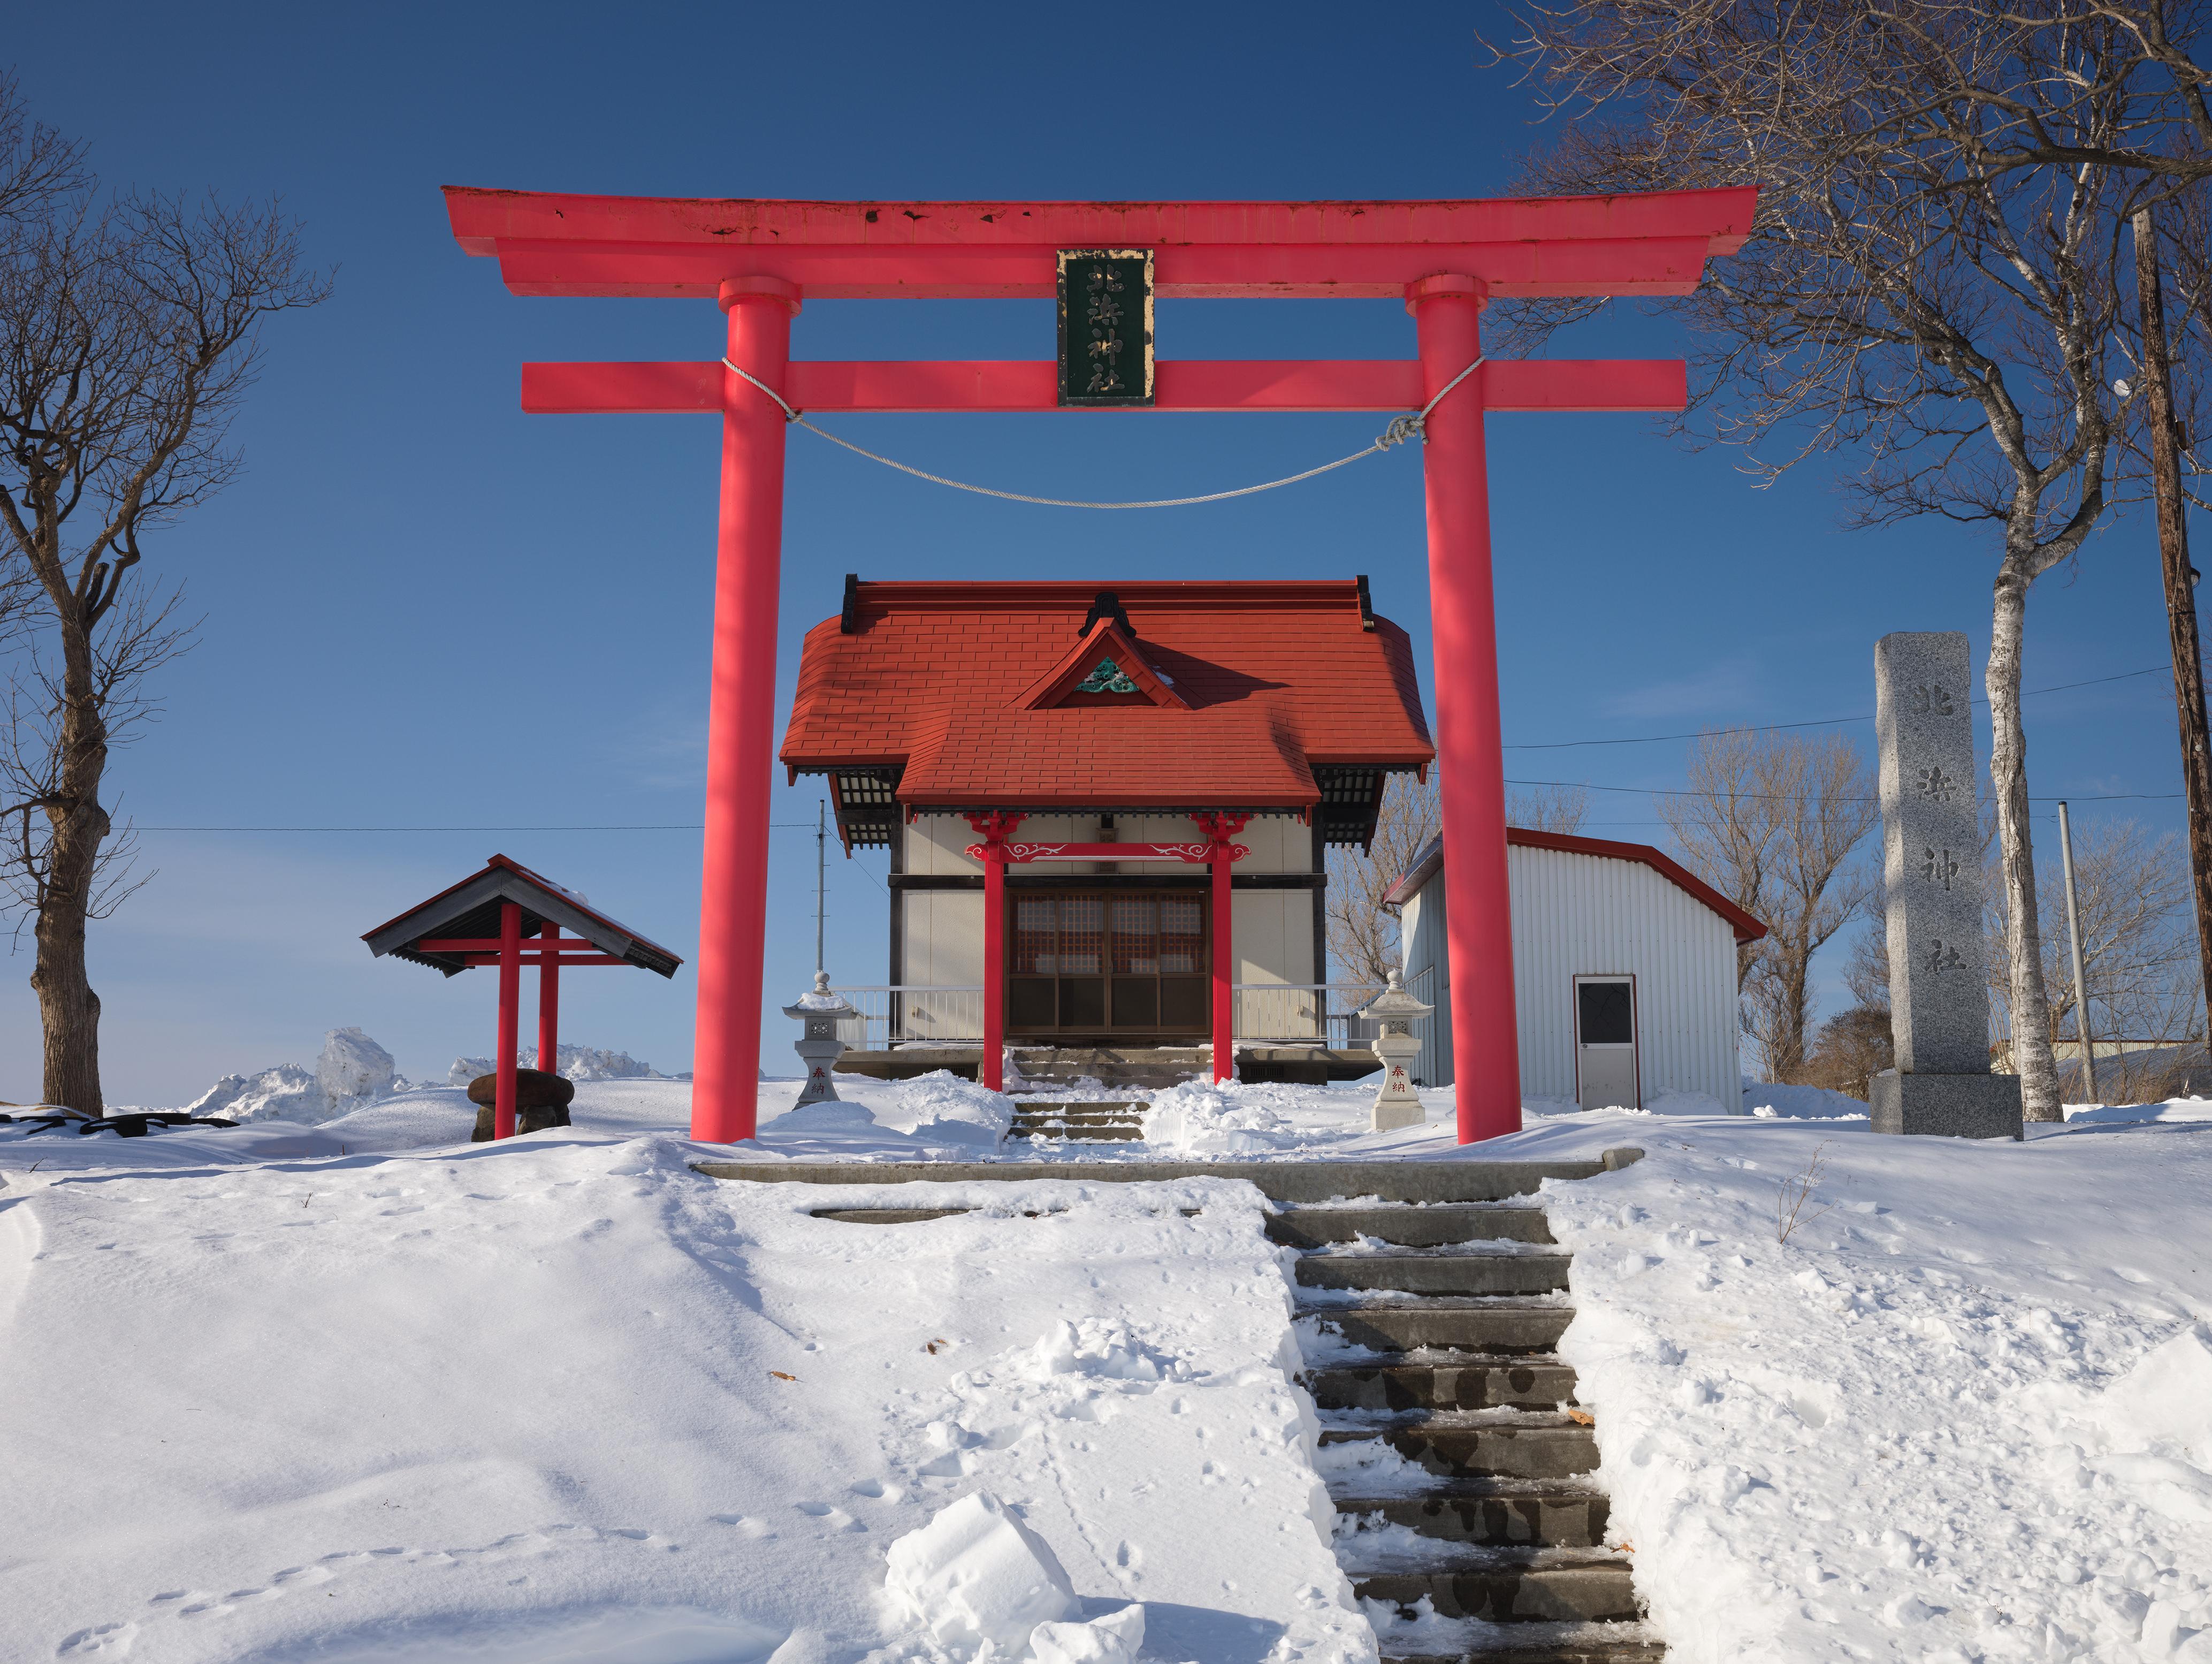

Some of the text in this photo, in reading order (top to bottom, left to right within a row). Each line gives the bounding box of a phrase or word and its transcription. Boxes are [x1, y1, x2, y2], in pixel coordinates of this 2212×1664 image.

[1086, 264, 1125, 393] 北浜神社
[1912, 685, 1966, 973] 北浜神社
[811, 1067, 826, 1095] 奉納
[1392, 1065, 1405, 1093] 奉納
